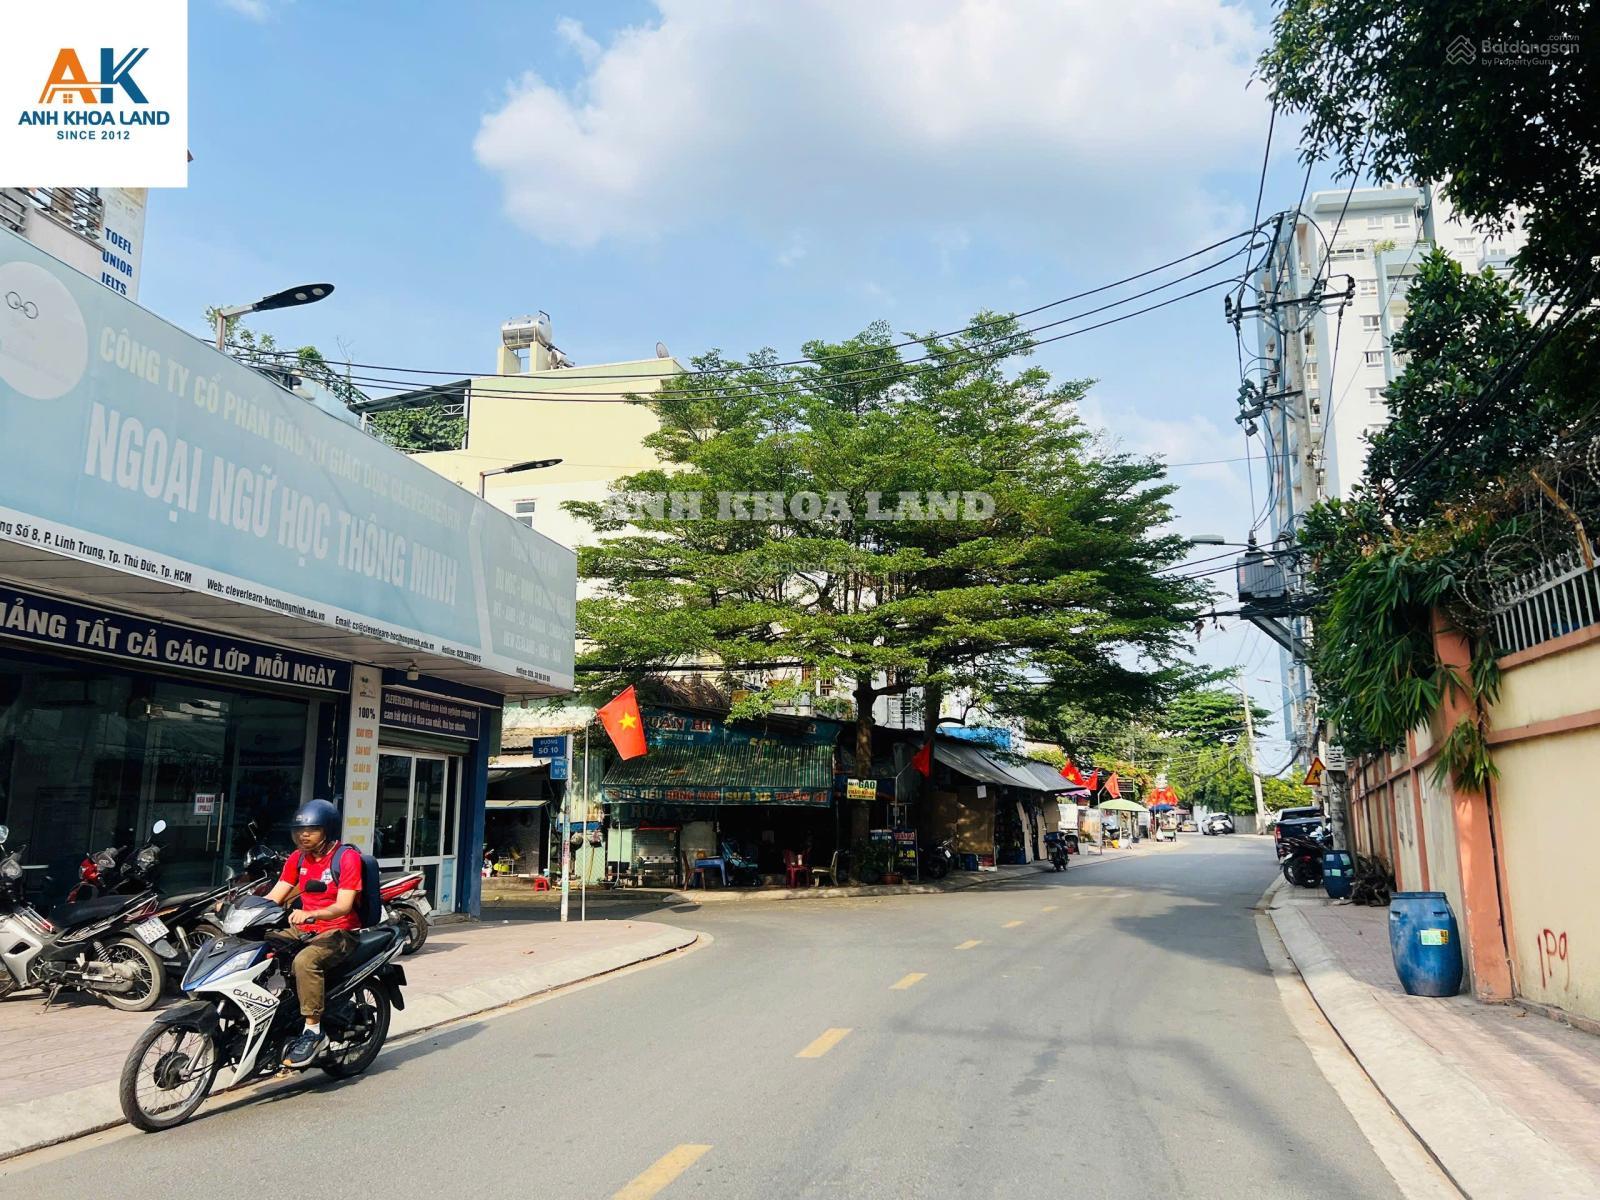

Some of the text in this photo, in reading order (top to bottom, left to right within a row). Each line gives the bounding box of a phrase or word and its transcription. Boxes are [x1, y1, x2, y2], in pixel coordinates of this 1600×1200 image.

[105, 226, 132, 255] TOEFL
[102, 249, 132, 278] UNIOR
[102, 272, 126, 296] IELTS
[101, 328, 160, 384] CÔNG
[167, 359, 191, 398] TY
[84, 401, 202, 523] NGOẠI
[208, 455, 278, 539] NGỮ
[278, 487, 331, 567] HỌC
[337, 511, 406, 585] THÔNG
[410, 541, 458, 606] MINH
[15, 523, 31, 538] Số
[55, 535, 76, 551] Linh
[78, 541, 106, 560] Trung,
[109, 550, 121, 564] Tp.
[124, 554, 139, 568] Thủ
[161, 564, 172, 578] Tp.
[174, 569, 192, 584] HCM
[208, 579, 224, 593] Web:
[76, 616, 121, 650] TẤT
[127, 628, 158, 659] CẢ
[165, 637, 207, 667] CÁC
[214, 646, 250, 672] LỚP
[255, 652, 288, 680] MỖI
[293, 663, 336, 687] NGÀY
[358, 706, 376, 720] 100%
[232, 988, 278, 1005] GALAXY
